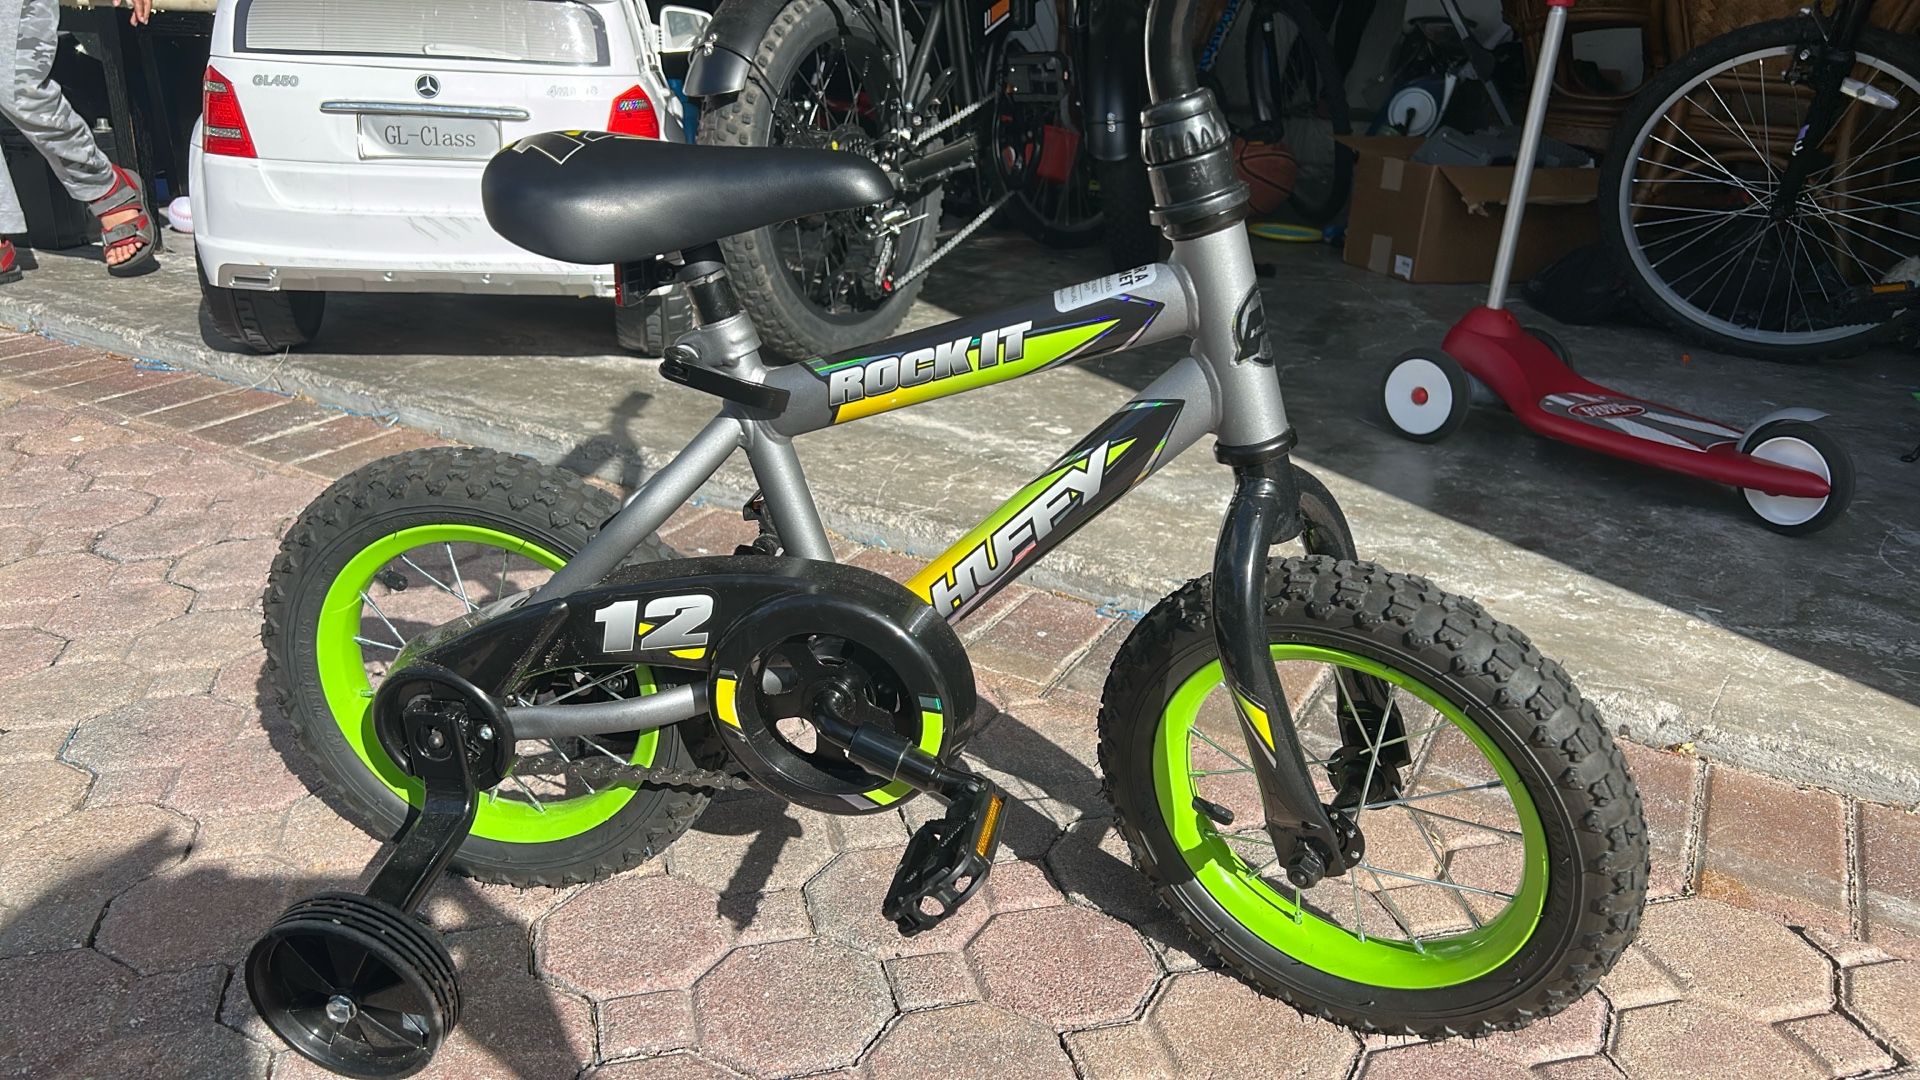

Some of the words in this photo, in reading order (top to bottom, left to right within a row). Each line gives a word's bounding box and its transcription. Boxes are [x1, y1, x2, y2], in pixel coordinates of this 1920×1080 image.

[252, 74, 299, 87] GL450
[384, 125, 476, 147] GL-Class
[828, 335, 974, 407] ROCK
[979, 320, 1033, 369] IT
[929, 439, 1110, 619] HUFFY
[594, 593, 714, 653] 12
